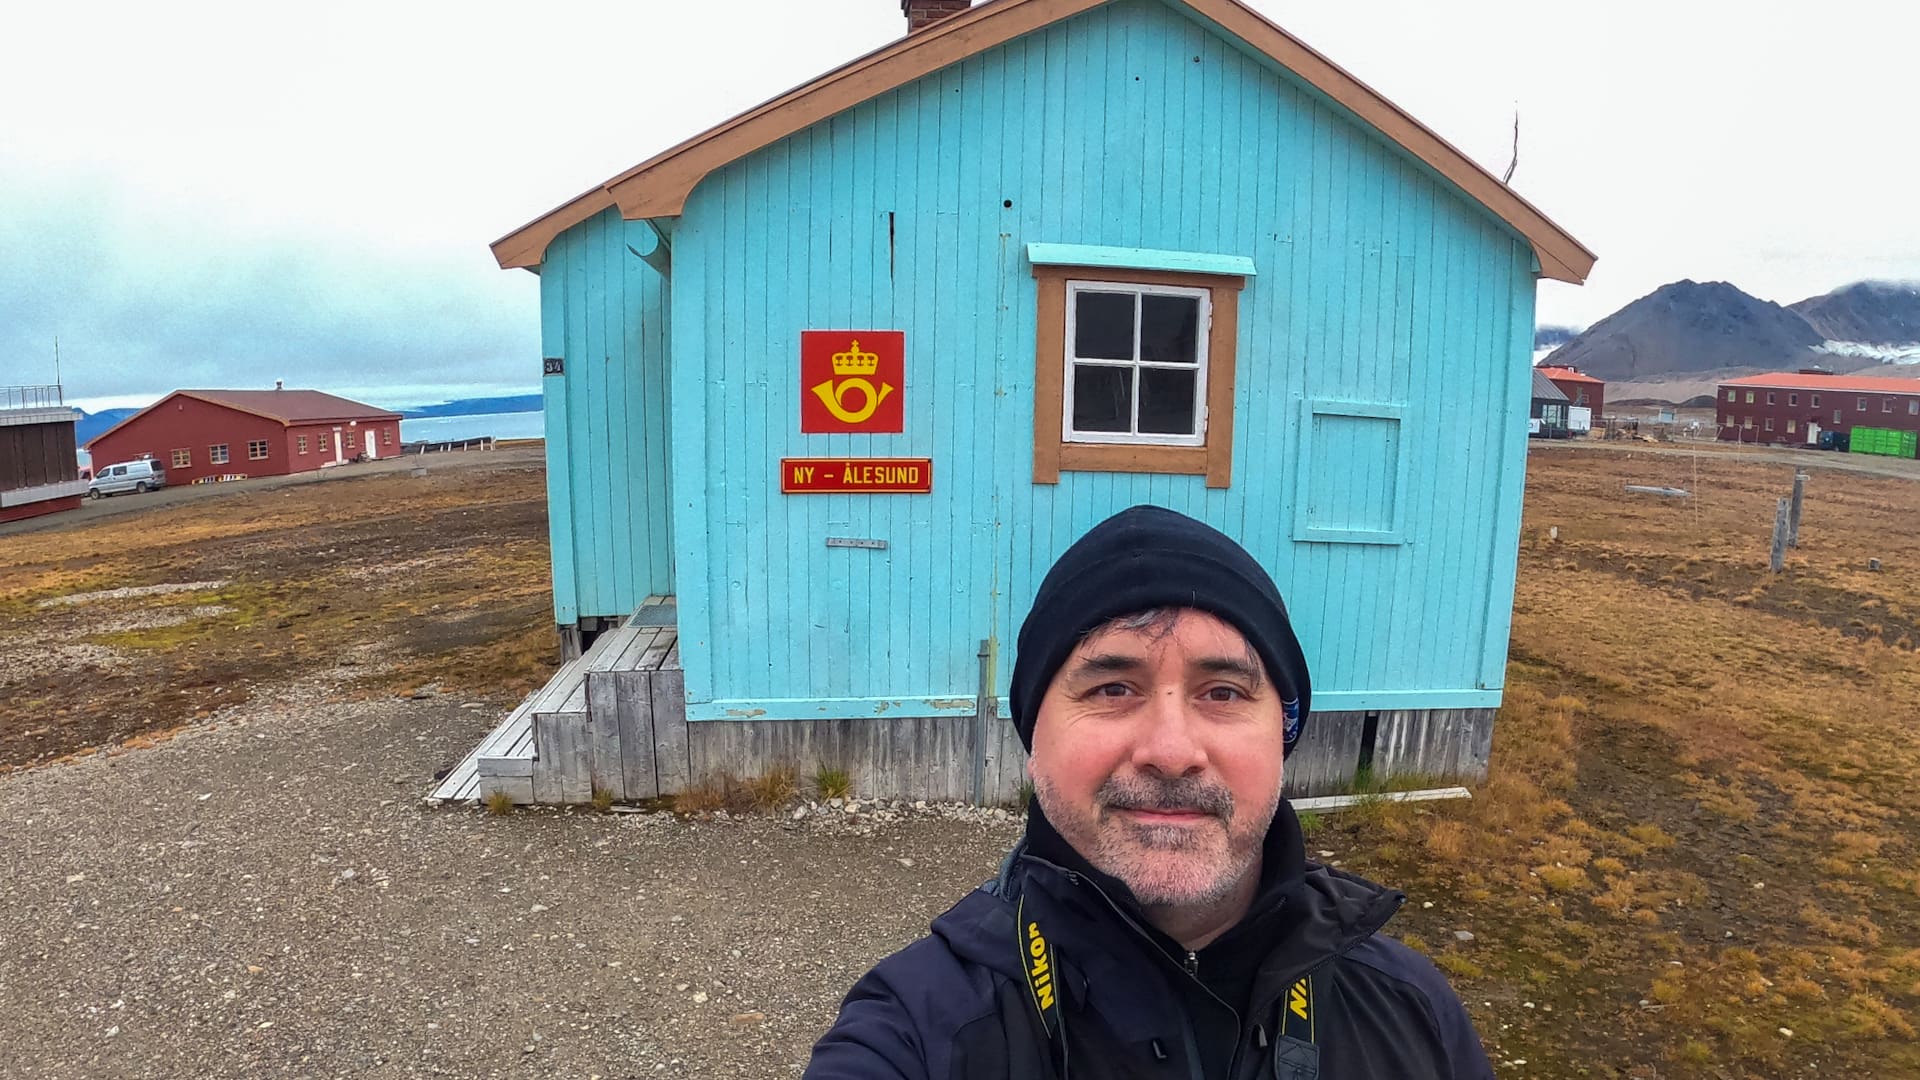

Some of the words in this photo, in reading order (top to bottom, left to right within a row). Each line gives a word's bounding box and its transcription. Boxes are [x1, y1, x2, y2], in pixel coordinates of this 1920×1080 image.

[794, 466, 815, 484] NY
[843, 462, 919, 484] ÅLESUND
[1290, 978, 1308, 1020] Ni
